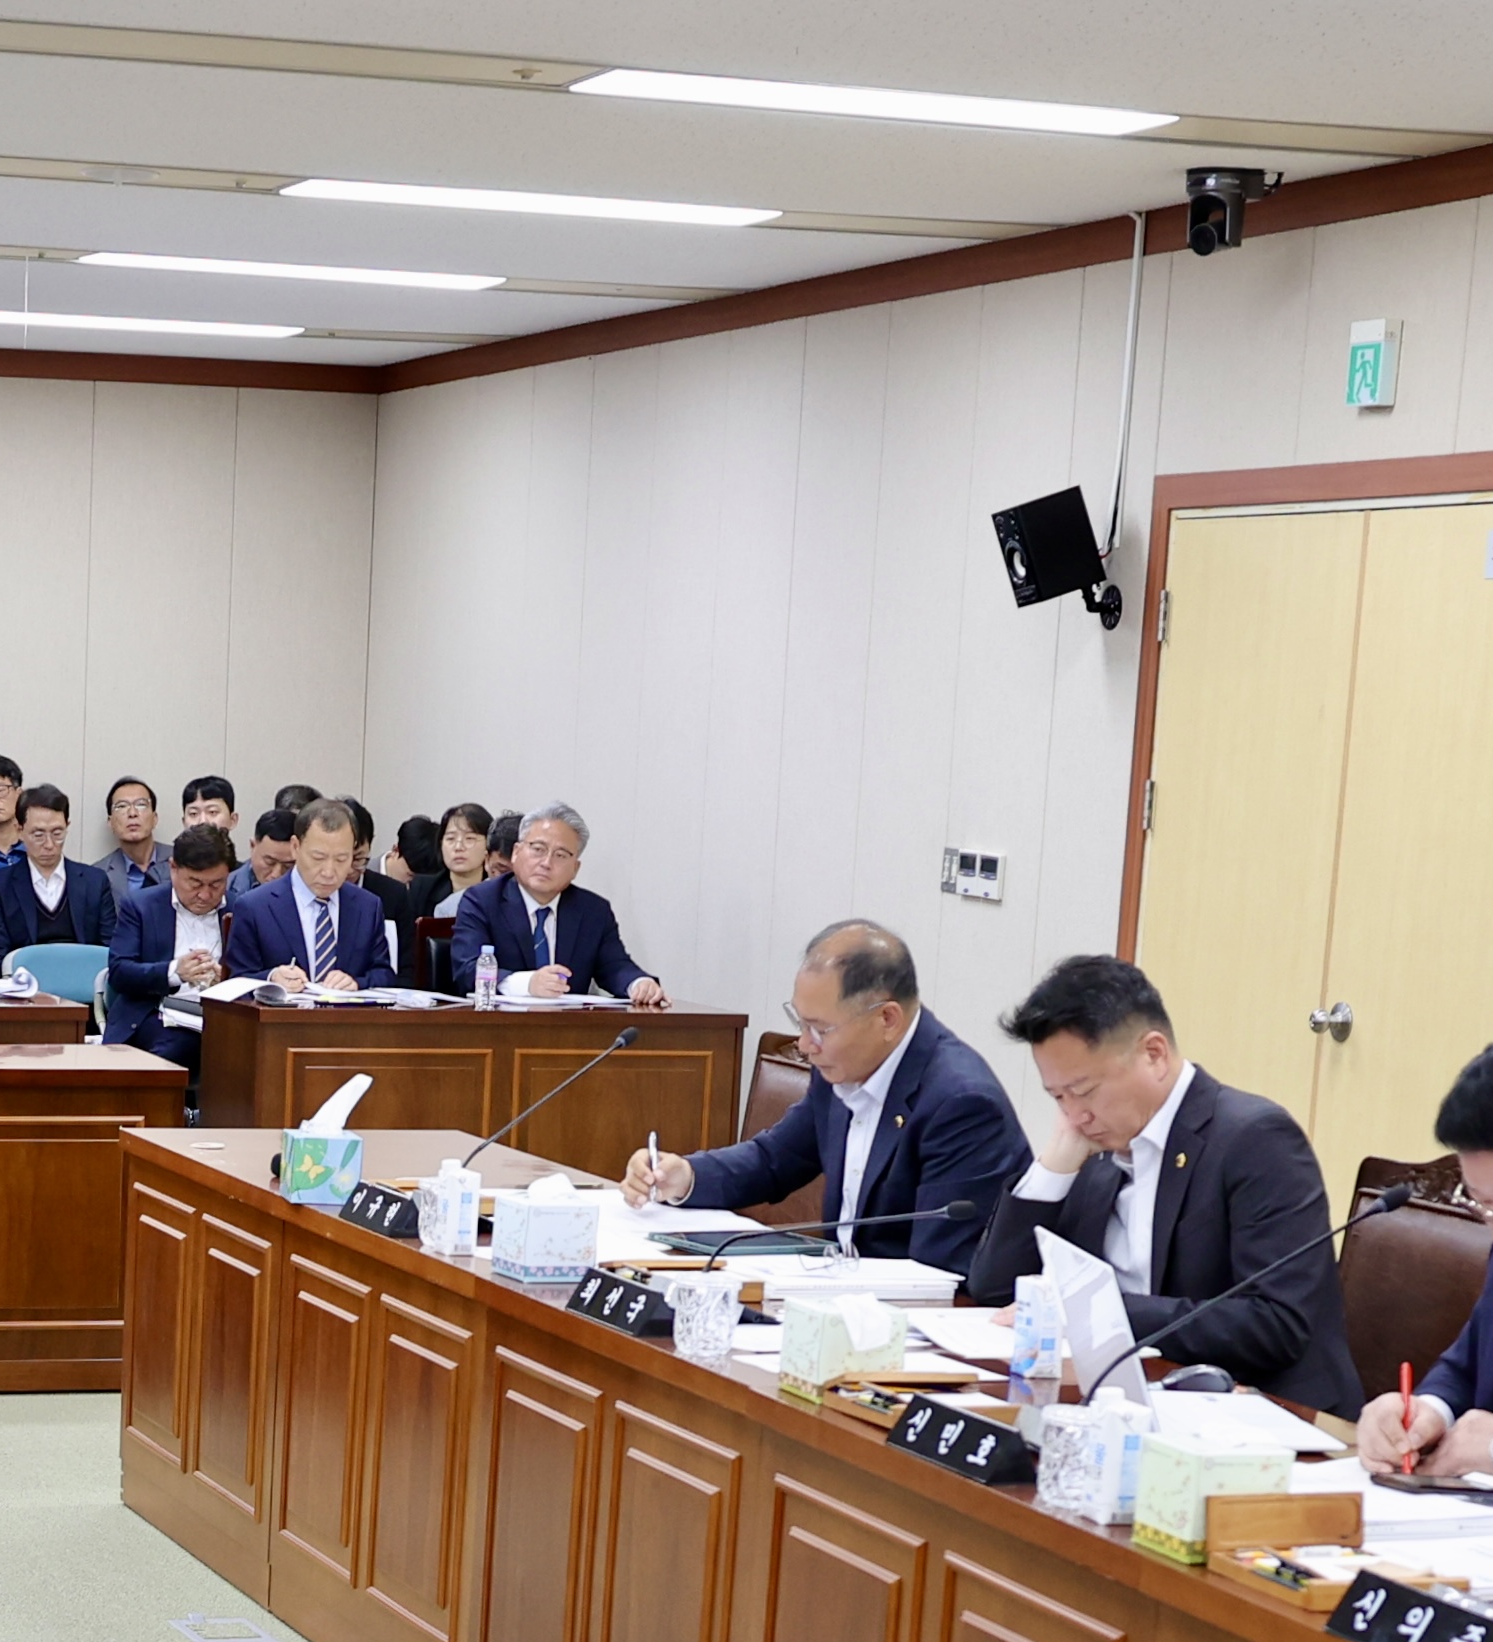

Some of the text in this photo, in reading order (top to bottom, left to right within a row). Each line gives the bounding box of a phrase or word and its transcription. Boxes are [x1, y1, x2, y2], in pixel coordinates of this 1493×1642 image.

[351, 1188, 402, 1228] 이규현
[579, 1277, 648, 1325] 최선국
[905, 1406, 997, 1467] 신민호
